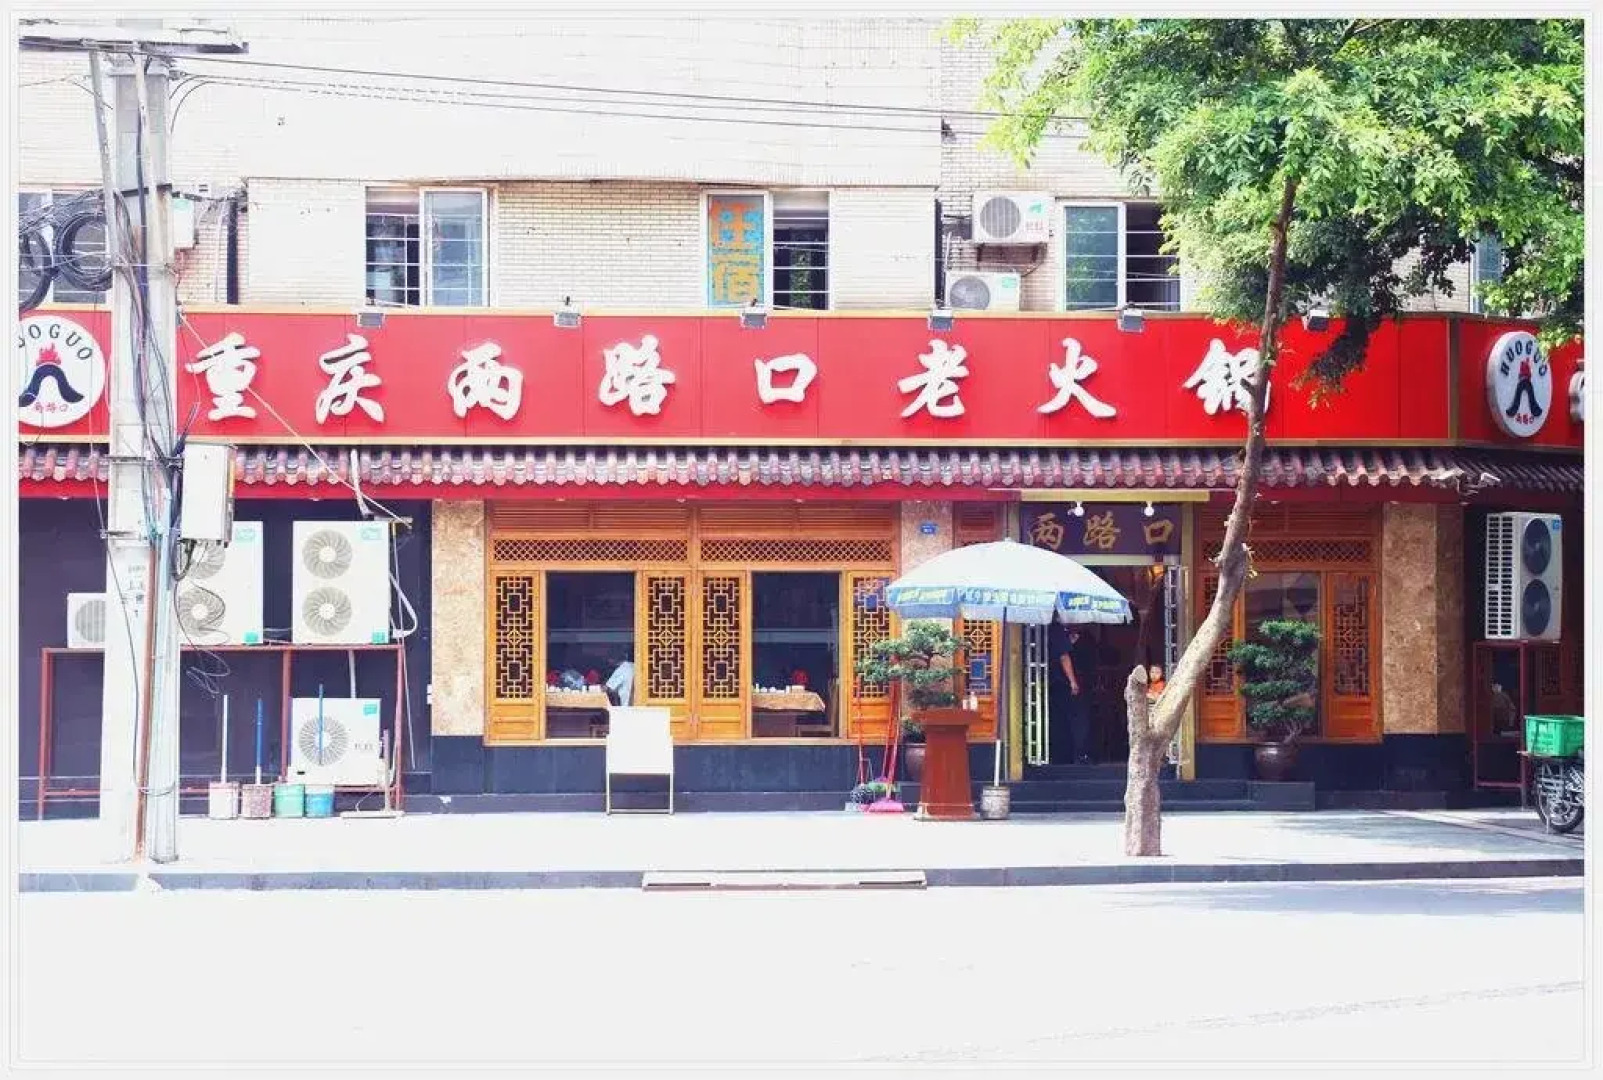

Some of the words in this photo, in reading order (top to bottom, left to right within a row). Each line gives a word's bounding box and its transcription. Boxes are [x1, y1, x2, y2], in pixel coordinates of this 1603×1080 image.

[186, 333, 1271, 423] 重庆两路口老火锅
[1027, 510, 1174, 550] 两路口
